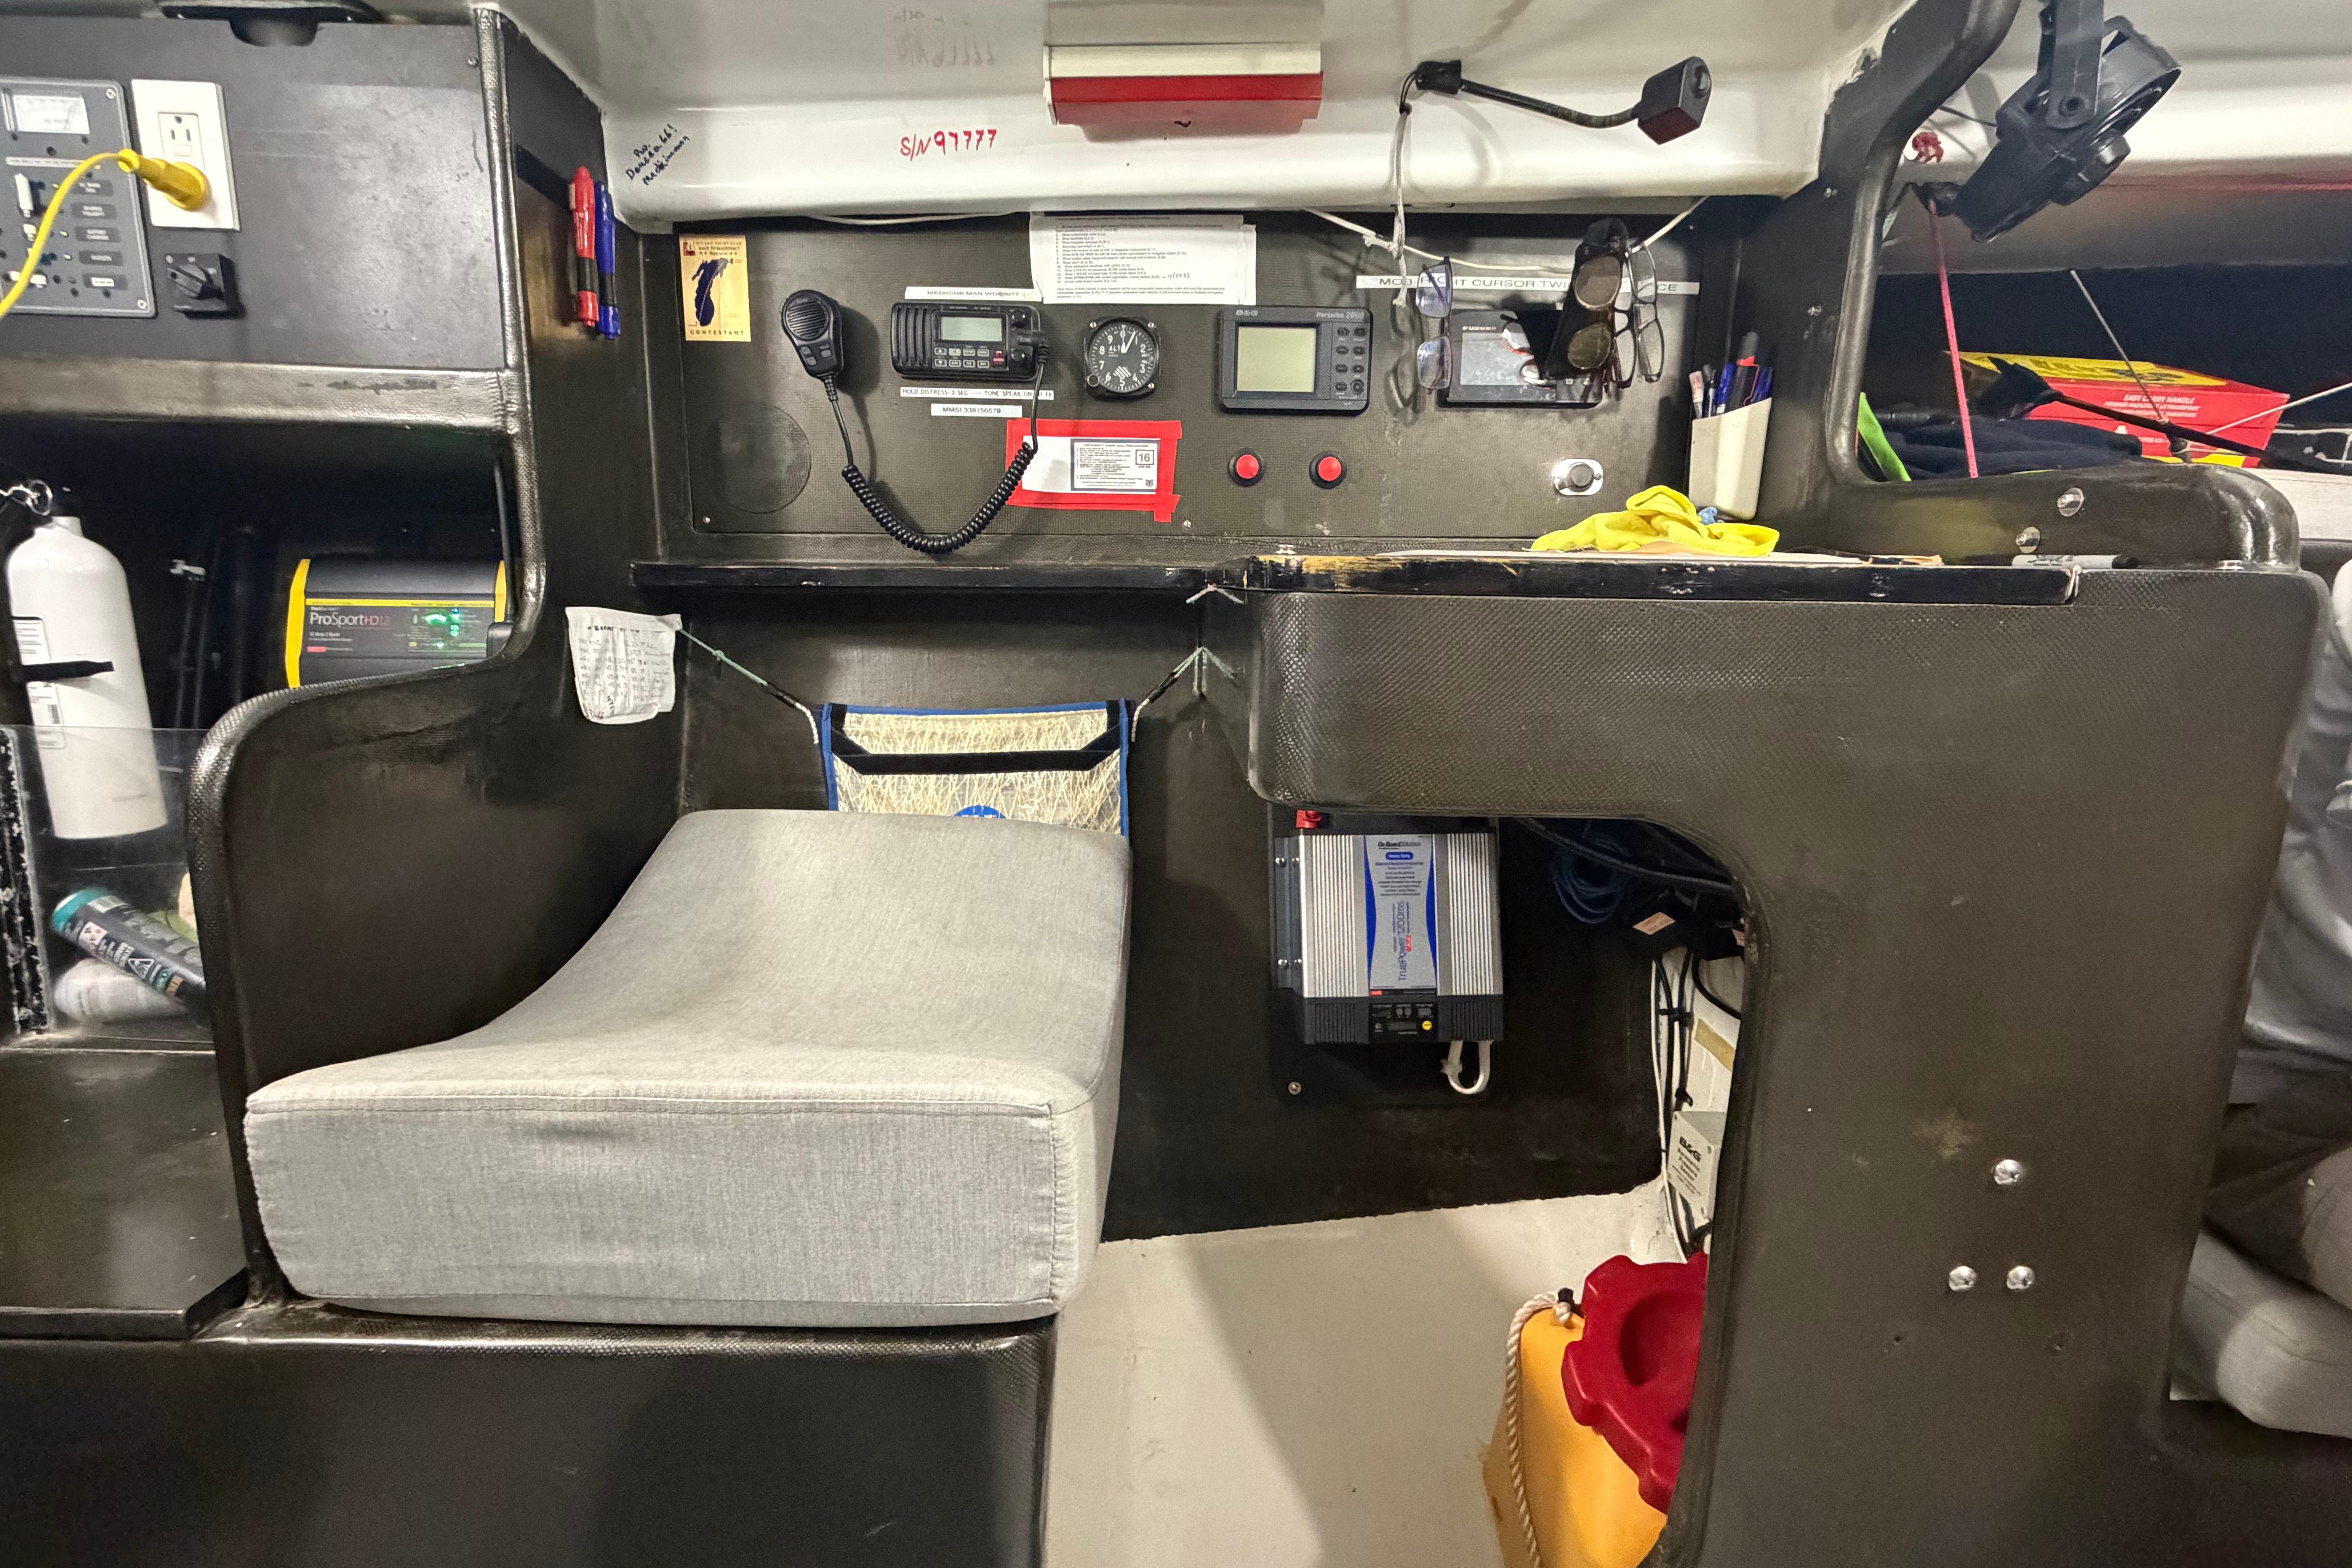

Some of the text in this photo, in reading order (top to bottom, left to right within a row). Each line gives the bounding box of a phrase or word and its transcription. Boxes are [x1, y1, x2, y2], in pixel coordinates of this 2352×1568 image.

[1472, 280, 1535, 288] CURSOR
[1107, 335, 1113, 344] 9
[1099, 345, 1105, 355] 8
[1140, 343, 1146, 353] 2
[1099, 360, 1105, 370] 7
[1139, 364, 1146, 373] 3
[1106, 372, 1111, 381] 6
[1119, 376, 1125, 386] 5
[1132, 372, 1138, 382] 4
[1139, 453, 1150, 462] 16
[1679, 1135, 1701, 1162] B&G
